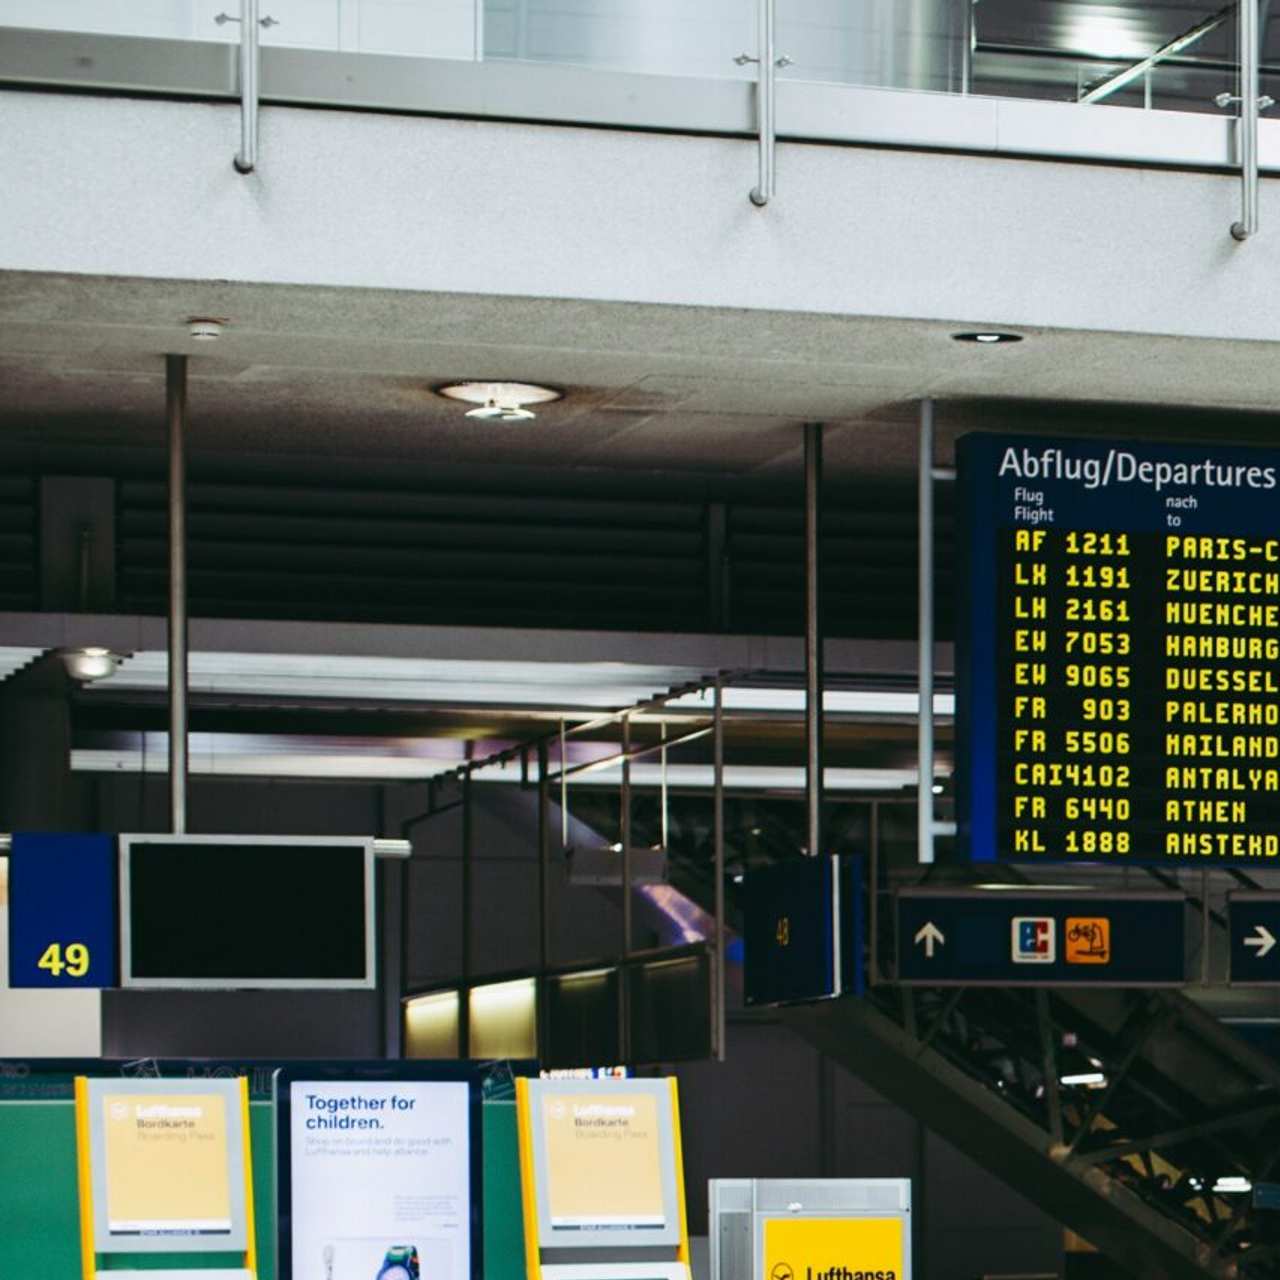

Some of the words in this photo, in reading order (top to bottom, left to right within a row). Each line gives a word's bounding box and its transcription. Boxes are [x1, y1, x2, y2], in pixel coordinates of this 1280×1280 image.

[999, 447, 1277, 491] Abflug/Departures
[1014, 486, 1045, 506] Flug
[1165, 494, 1199, 510] nach
[1014, 505, 1055, 525] Flight
[1166, 512, 1182, 527] to
[1015, 530, 1046, 551] AF
[1066, 533, 1130, 555] 1211
[1015, 597, 1046, 618] LH
[1066, 599, 1130, 621] 2161
[1015, 664, 1046, 684] EW
[1066, 665, 1130, 687] 9065
[1015, 697, 1046, 718] FR
[1082, 699, 1130, 720] 903
[1166, 701, 1279, 724] PALERMO
[1015, 730, 1046, 751] FR
[1065, 732, 1130, 753] 5506
[1015, 797, 1046, 817] FR
[1065, 798, 1130, 820] 6440
[1166, 800, 1246, 822] ATHEN
[37, 942, 91, 977] 49
[305, 1094, 387, 1113] Together
[390, 1094, 416, 1111] for
[136, 1118, 196, 1129] Bordkarte
[304, 1114, 386, 1131] children.
[574, 1117, 629, 1128] Bordkarte
